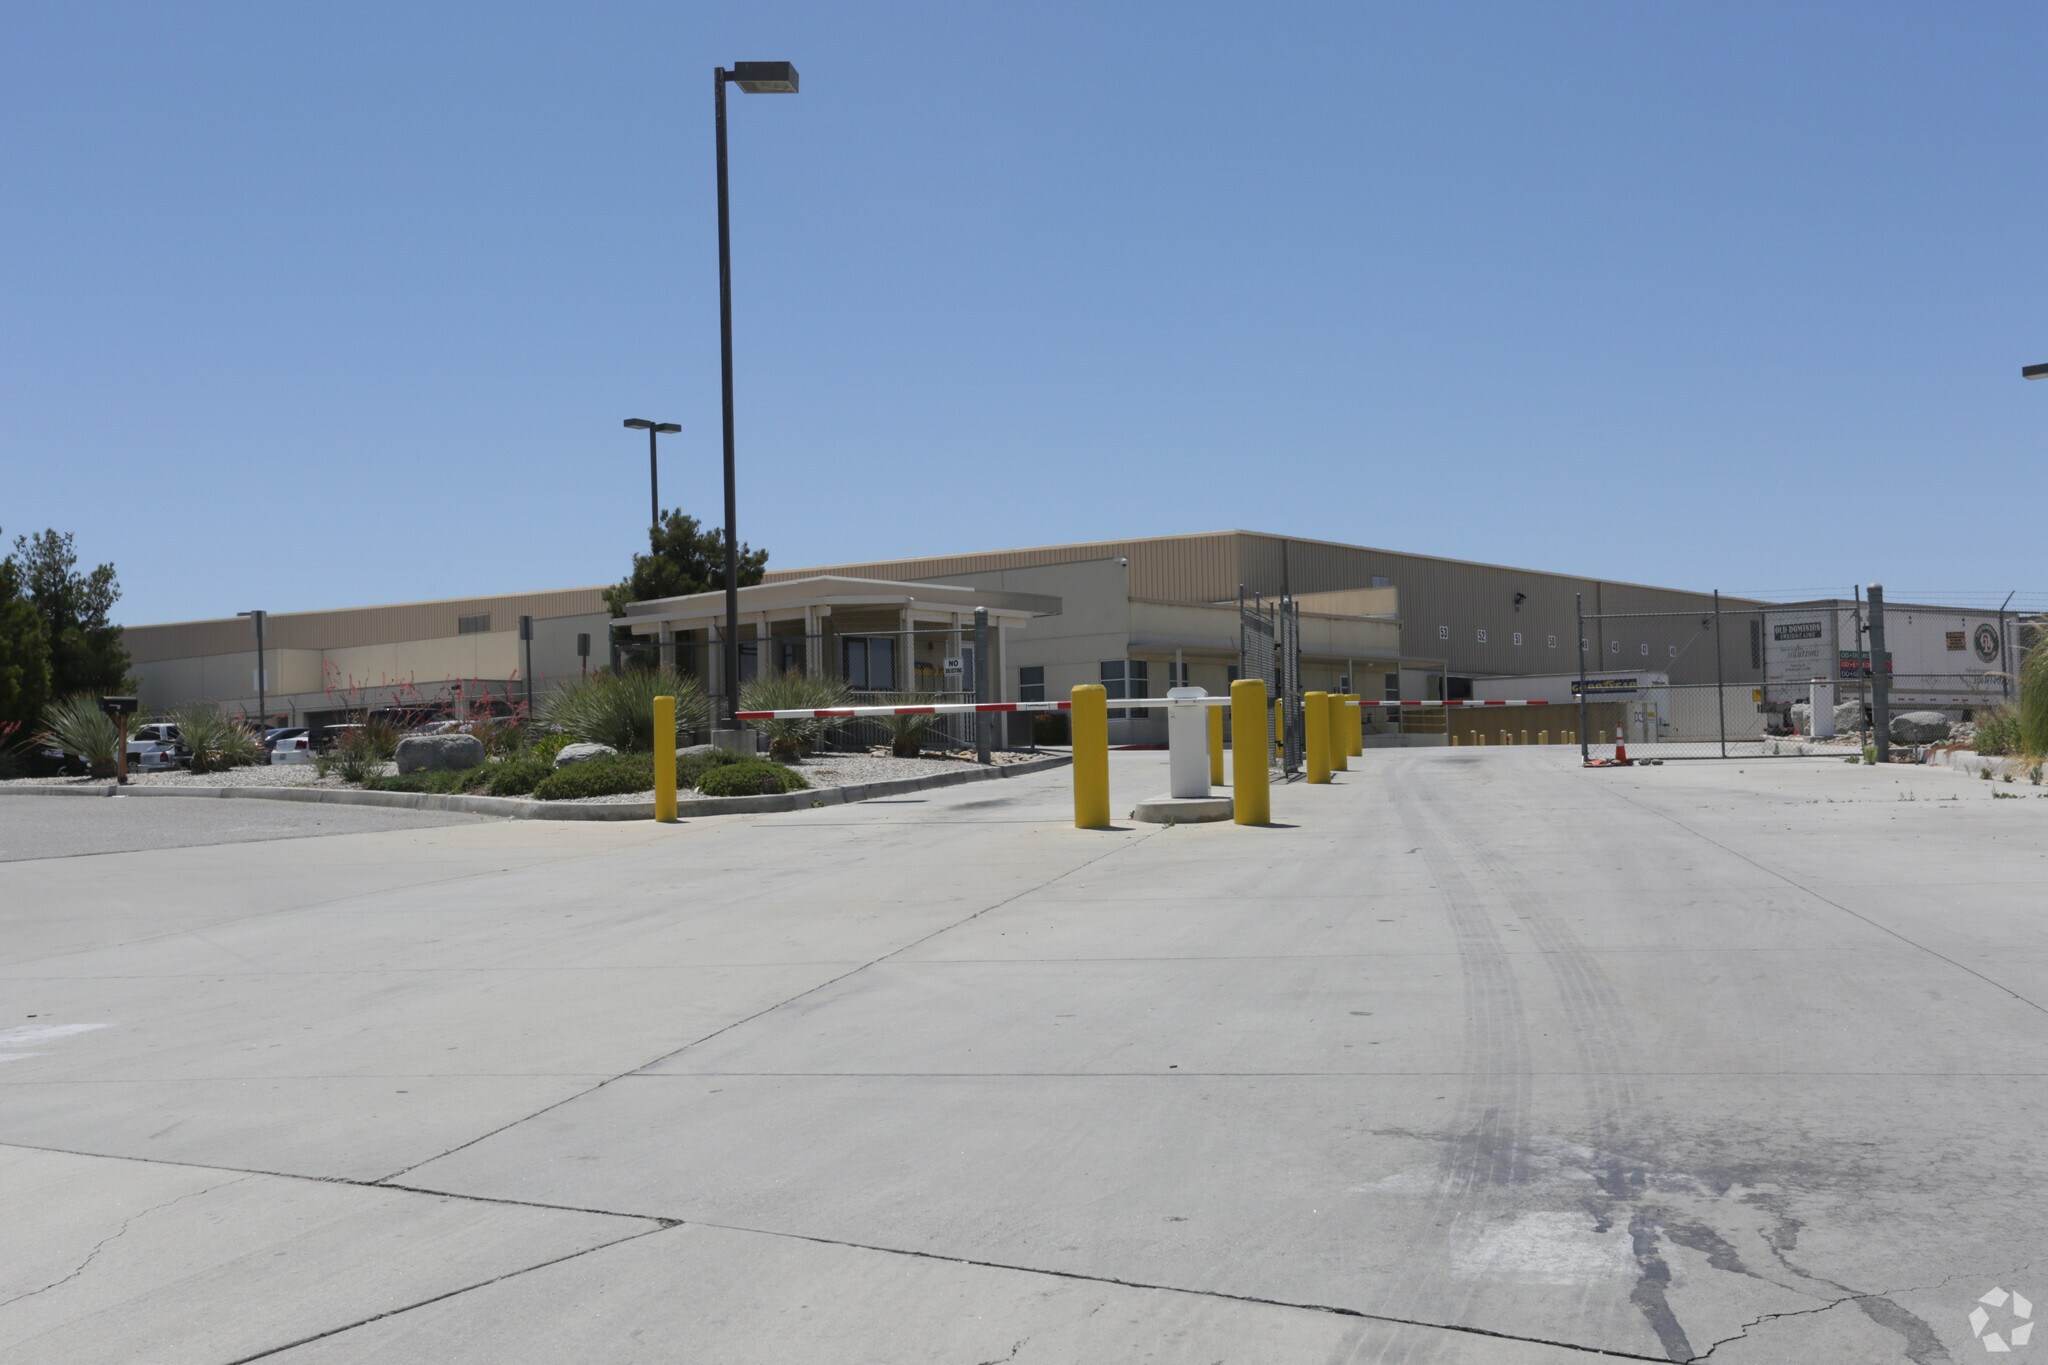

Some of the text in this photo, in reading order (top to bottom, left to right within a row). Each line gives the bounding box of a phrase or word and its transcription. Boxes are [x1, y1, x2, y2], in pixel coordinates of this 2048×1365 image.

[1774, 623, 1821, 634] OLD DOMINION
[948, 659, 959, 667] NO
